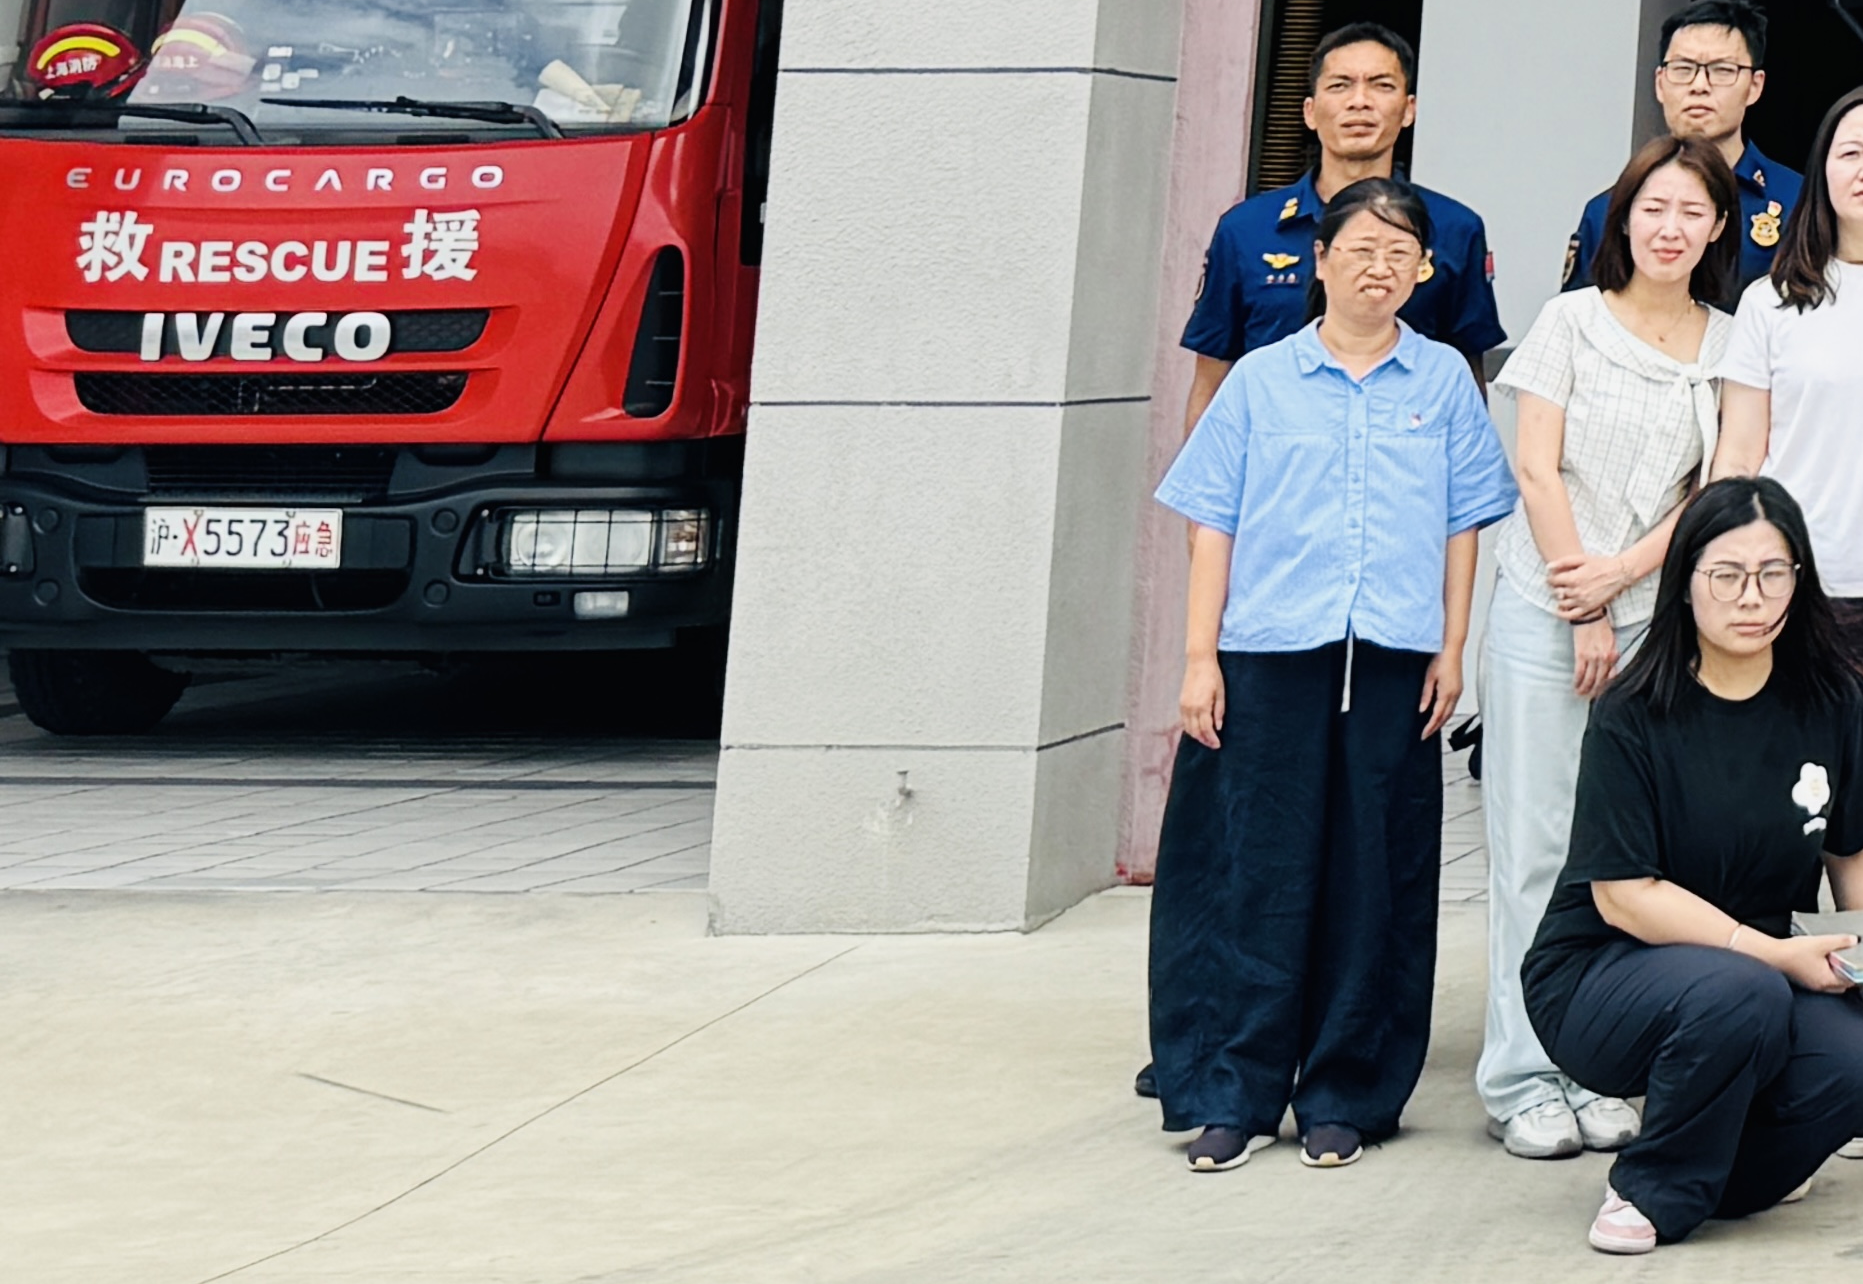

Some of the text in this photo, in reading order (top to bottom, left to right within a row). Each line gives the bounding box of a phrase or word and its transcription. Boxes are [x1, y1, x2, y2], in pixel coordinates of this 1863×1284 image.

[66, 164, 504, 192] EUROCARGO
[75, 208, 481, 283] 救 RESCUE 援
[139, 311, 392, 362] IVECO
